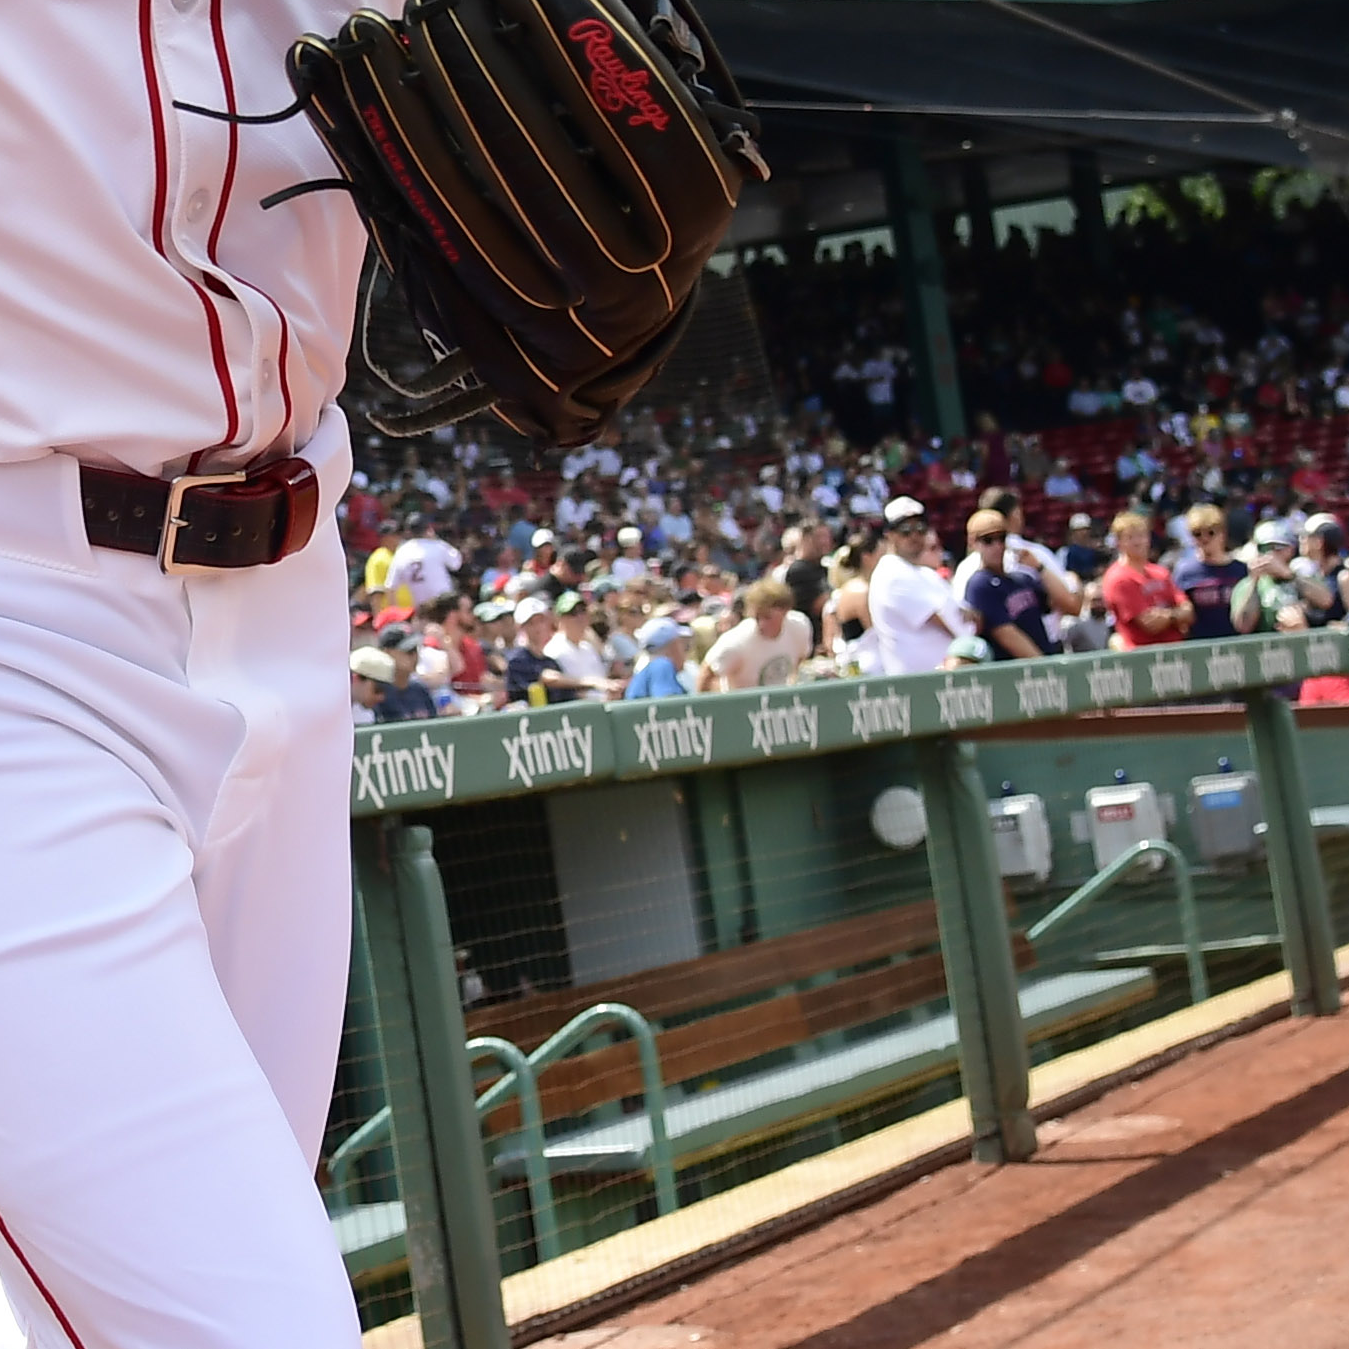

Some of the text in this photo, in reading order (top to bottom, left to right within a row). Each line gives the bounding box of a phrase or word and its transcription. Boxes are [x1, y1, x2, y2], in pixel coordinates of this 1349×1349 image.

[568, 18, 670, 131] Rawlings
[353, 732, 455, 809] xfinity
[502, 715, 593, 788] xfinity
[633, 705, 713, 771] xfinity
[748, 694, 818, 756] xfinity
[847, 683, 911, 743] xfinity
[935, 674, 994, 731] xfinity
